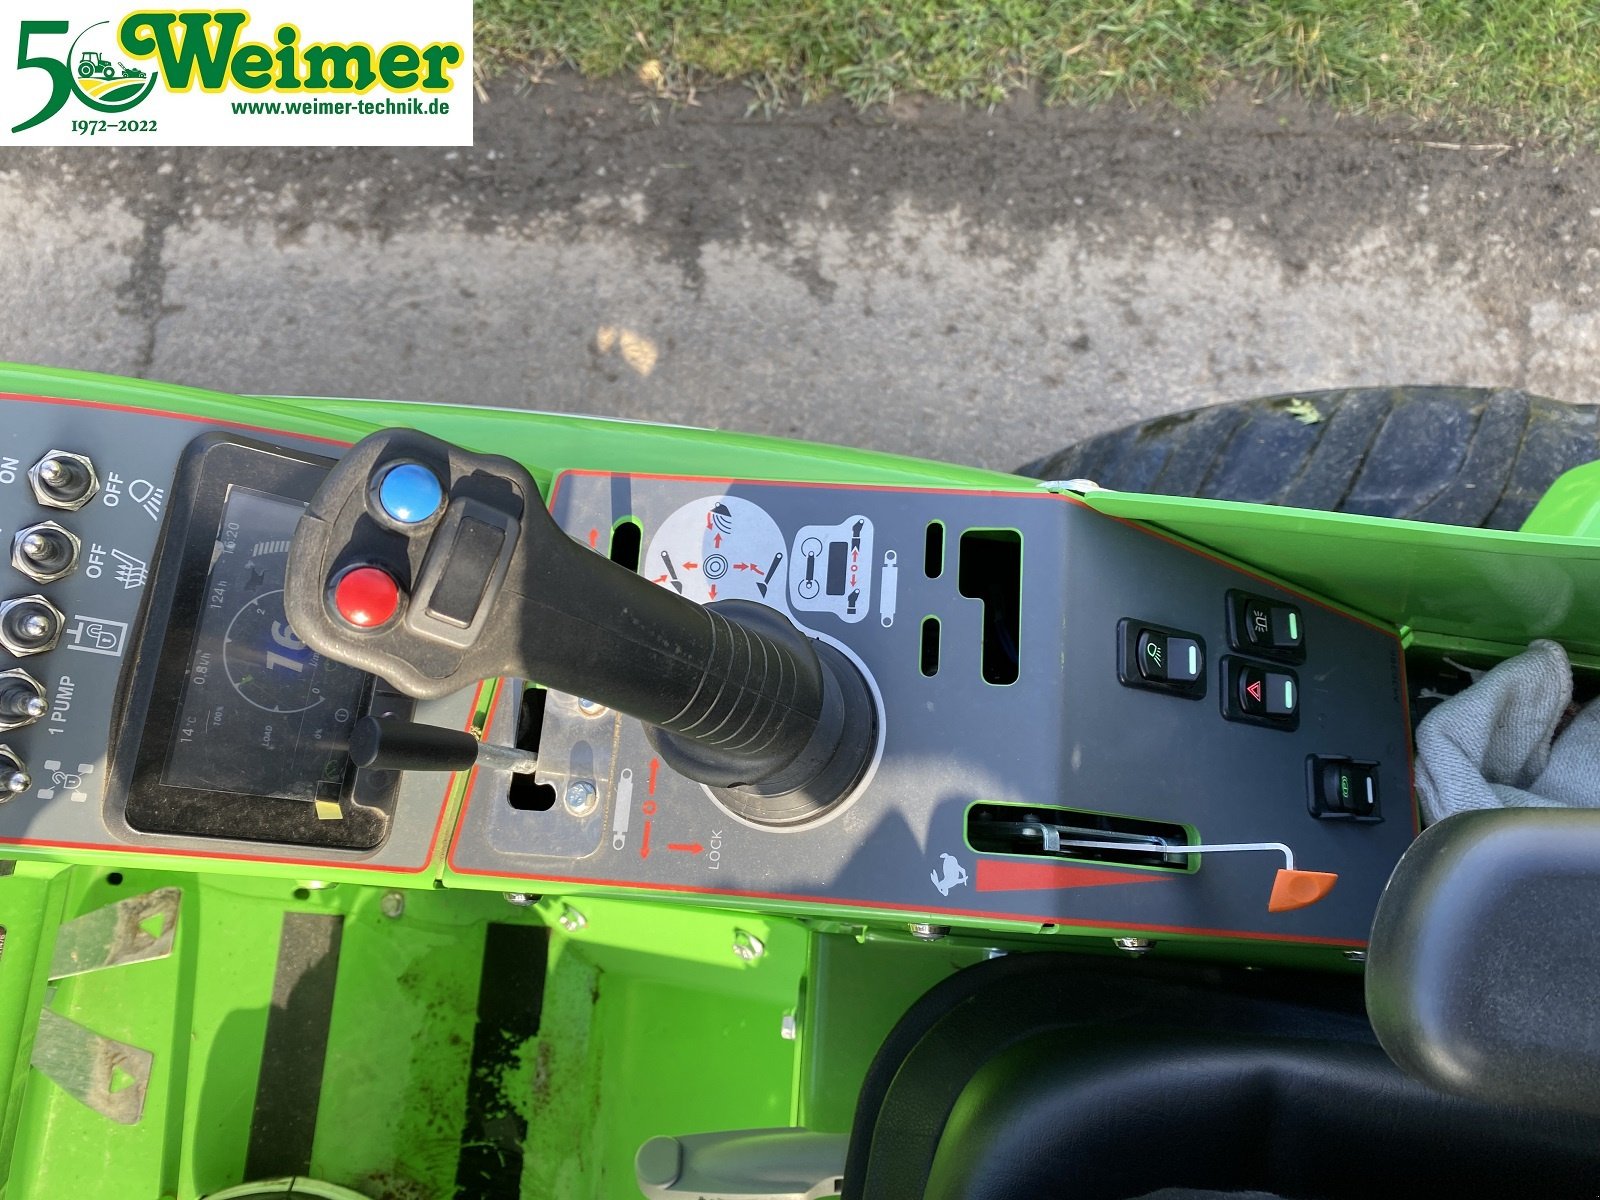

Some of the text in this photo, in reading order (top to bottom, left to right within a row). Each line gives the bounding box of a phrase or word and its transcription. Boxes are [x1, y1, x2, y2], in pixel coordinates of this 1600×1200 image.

[0, 457, 19, 484] ON
[103, 472, 123, 507] OFF
[223, 522, 240, 555] 16:20
[86, 543, 106, 579] OFF
[48, 675, 76, 735] 1 PUMP
[262, 725, 273, 748] LOAD
[708, 830, 722, 869] LOCK
